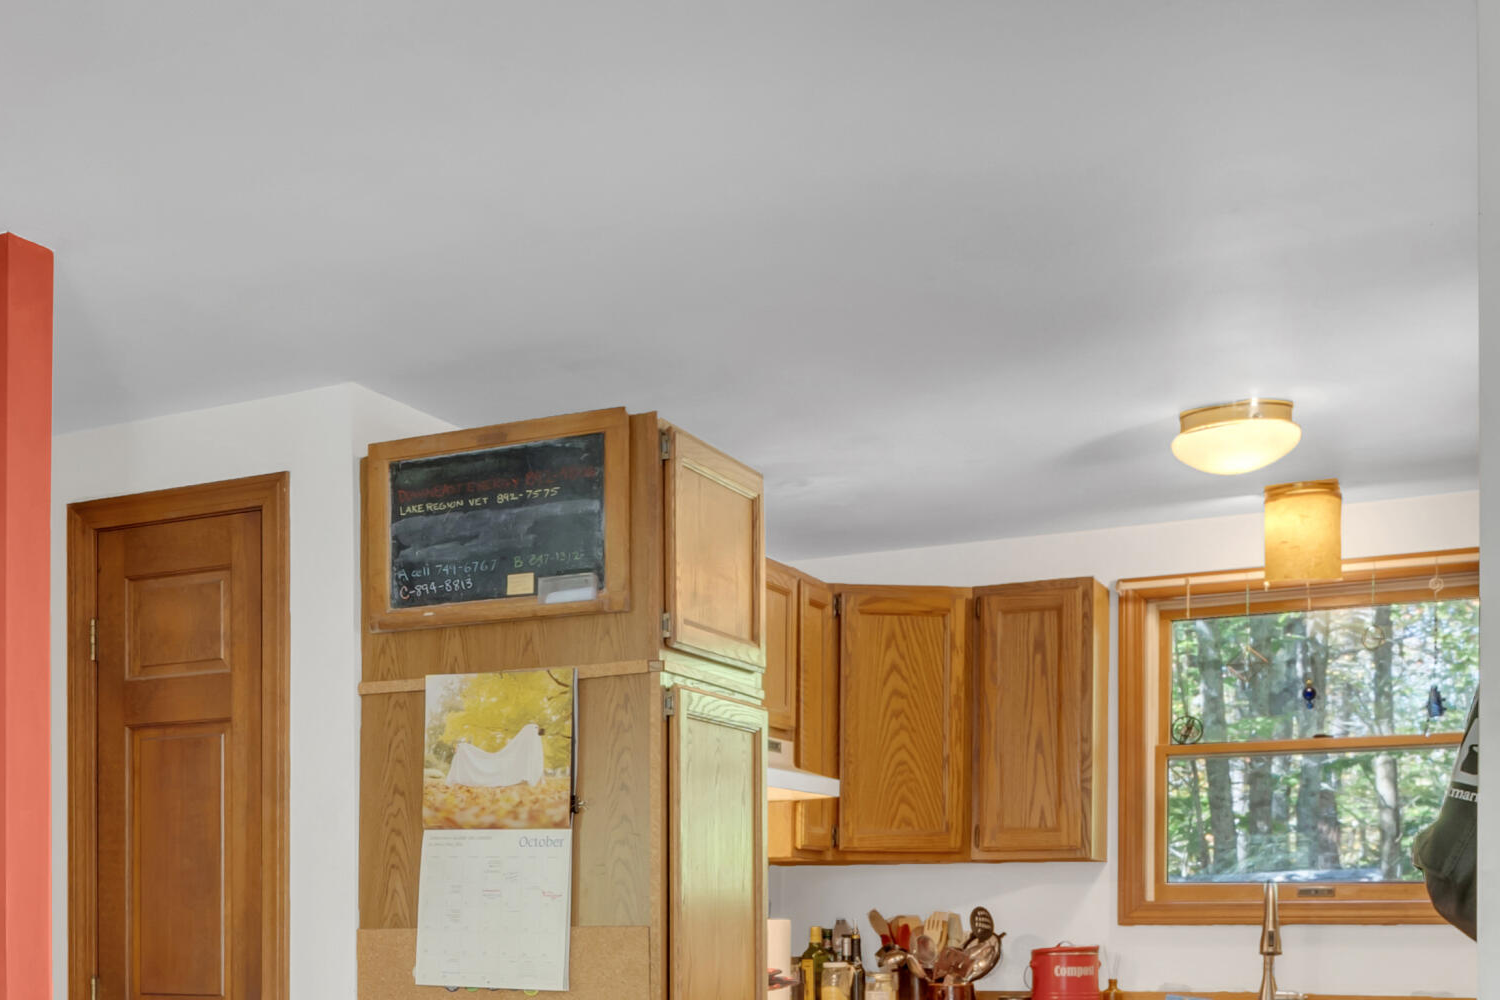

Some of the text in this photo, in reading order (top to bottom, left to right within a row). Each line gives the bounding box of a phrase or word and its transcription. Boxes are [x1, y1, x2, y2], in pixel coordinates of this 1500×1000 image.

[399, 486, 561, 516] LAKE REGION VET 892-7575
[513, 555, 524, 568] B
[411, 565, 430, 578] cell
[518, 835, 565, 848] October
[1053, 965, 1095, 978] Compost
